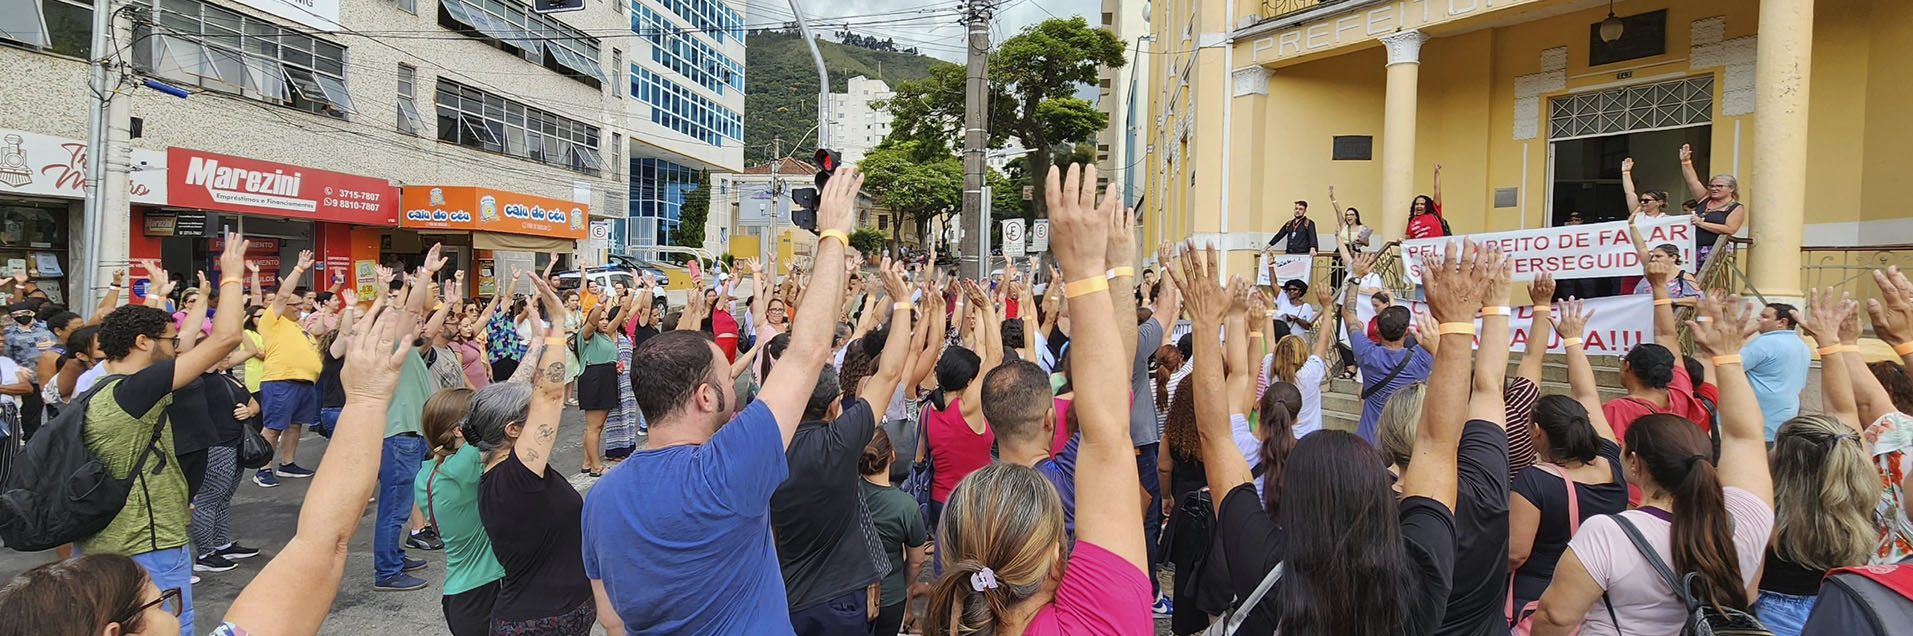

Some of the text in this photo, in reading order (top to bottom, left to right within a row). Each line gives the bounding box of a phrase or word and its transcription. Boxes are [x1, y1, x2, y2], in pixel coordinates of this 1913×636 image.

[1252, 0, 1492, 62] PREFEITU
[185, 156, 301, 197] Marezini
[216, 192, 259, 203] Empréstimos
[339, 189, 380, 201] 3715-7807
[332, 199, 380, 212] 9 8810-7807
[505, 204, 566, 222] caiu do céu
[408, 210, 469, 221] caiu do céu
[1559, 232, 1590, 249] DE
[1599, 224, 1689, 246] FAAR
